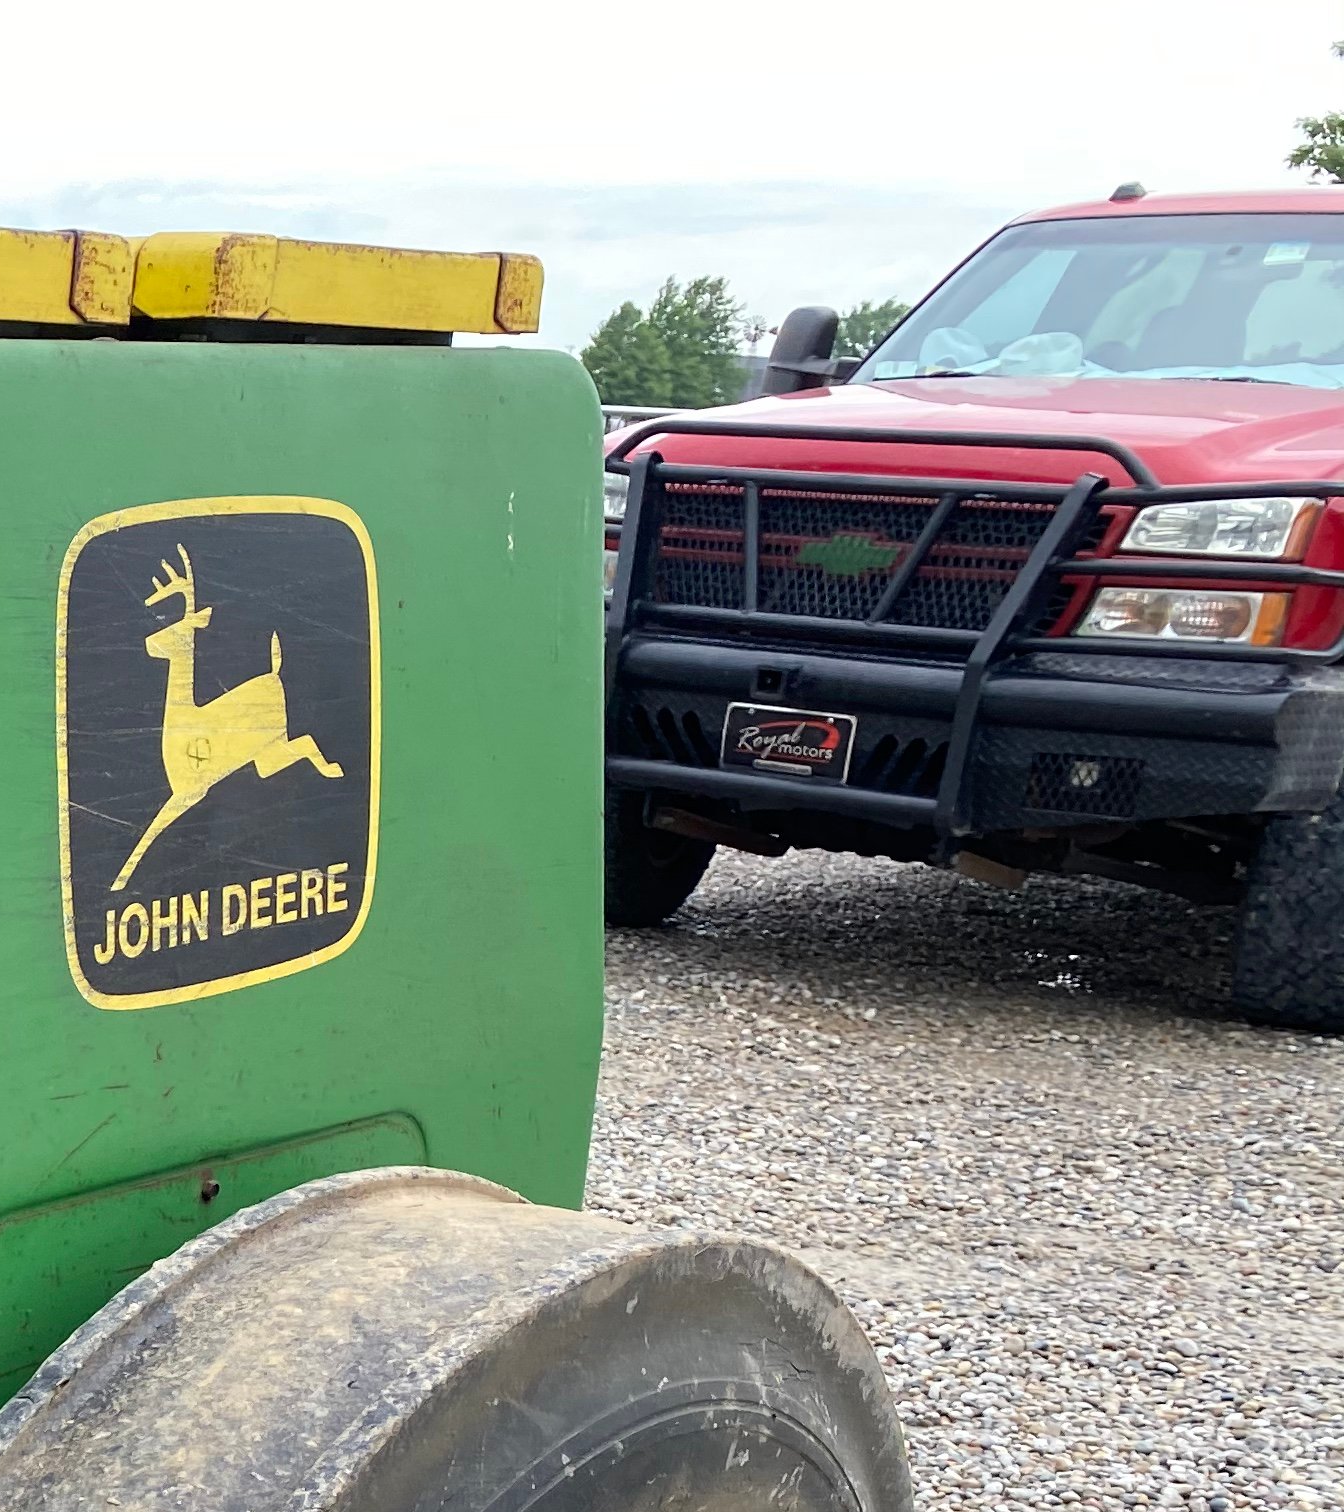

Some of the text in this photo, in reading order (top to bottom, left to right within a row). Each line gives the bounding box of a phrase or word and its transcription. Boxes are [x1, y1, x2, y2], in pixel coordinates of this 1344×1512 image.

[738, 721, 806, 759] Royal
[778, 744, 834, 760] motors
[93, 862, 349, 965] JOHN DEERE
